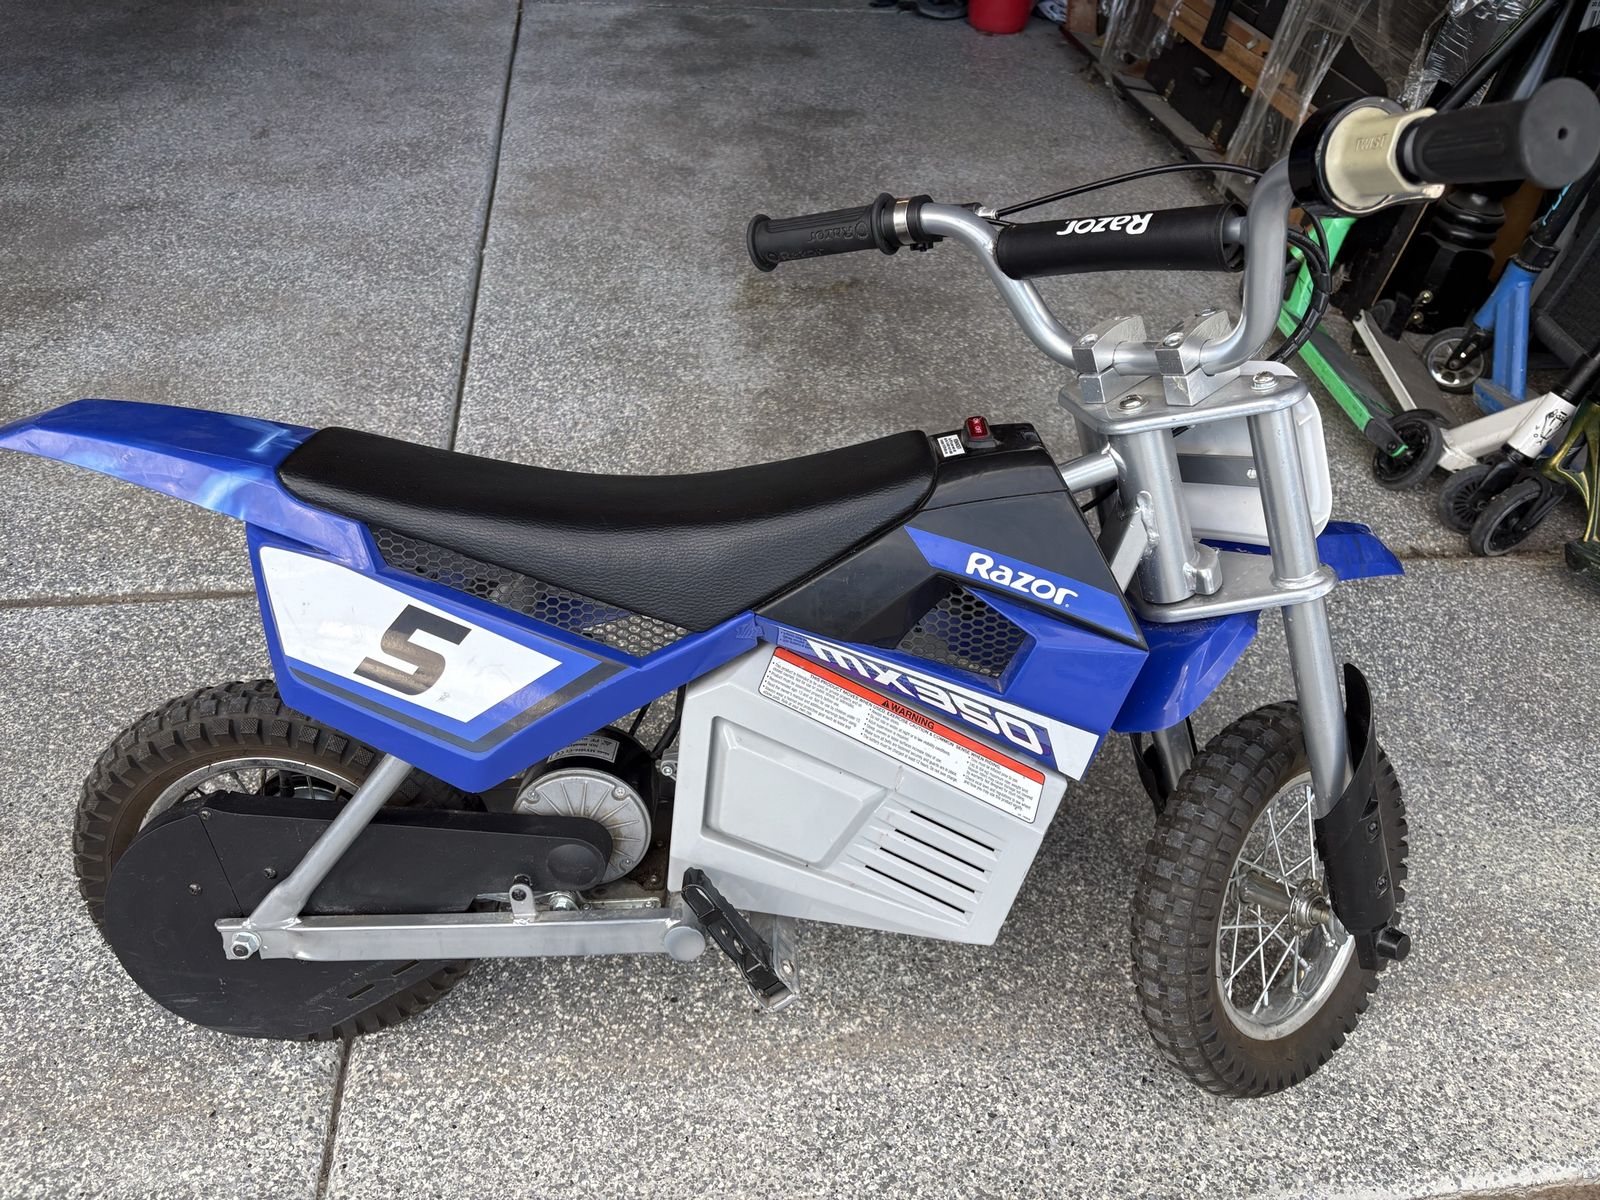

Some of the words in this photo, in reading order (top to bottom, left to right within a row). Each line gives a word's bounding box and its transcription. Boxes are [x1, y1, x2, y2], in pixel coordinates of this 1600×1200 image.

[1355, 133, 1388, 151] TWIST
[820, 679, 842, 693] PRODUCT
[842, 690, 859, 701] MOVES
[859, 698, 873, 708] WHEN
[909, 722, 929, 735] CAUTION
[933, 734, 955, 747] COMMON
[955, 745, 970, 755] SENSE
[971, 752, 984, 762] WHEN
[890, 703, 935, 730] WARNING
